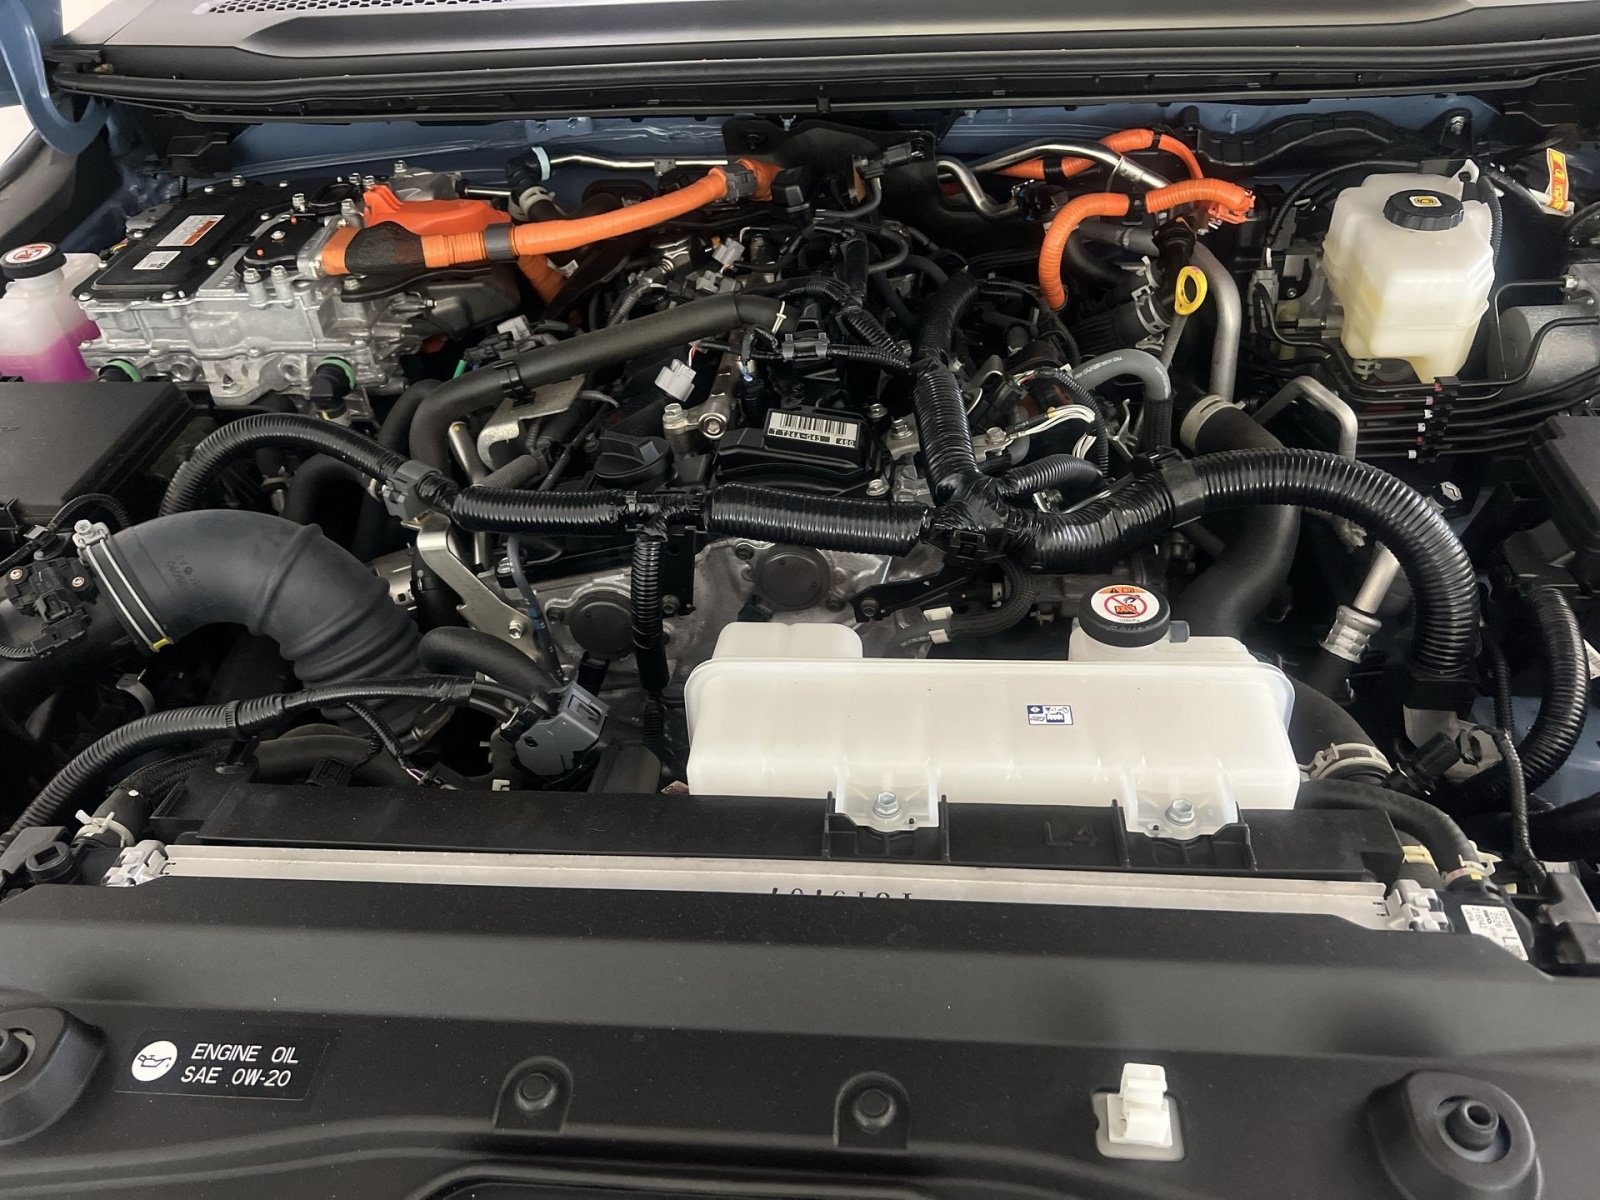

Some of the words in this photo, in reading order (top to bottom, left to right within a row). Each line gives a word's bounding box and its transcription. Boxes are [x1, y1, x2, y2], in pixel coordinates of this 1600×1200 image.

[1045, 821, 1096, 847] L4
[191, 1043, 262, 1063] ENGINE
[271, 1046, 299, 1064] OIL
[181, 1066, 222, 1084] SAE
[231, 1068, 292, 1086] 0W-20
